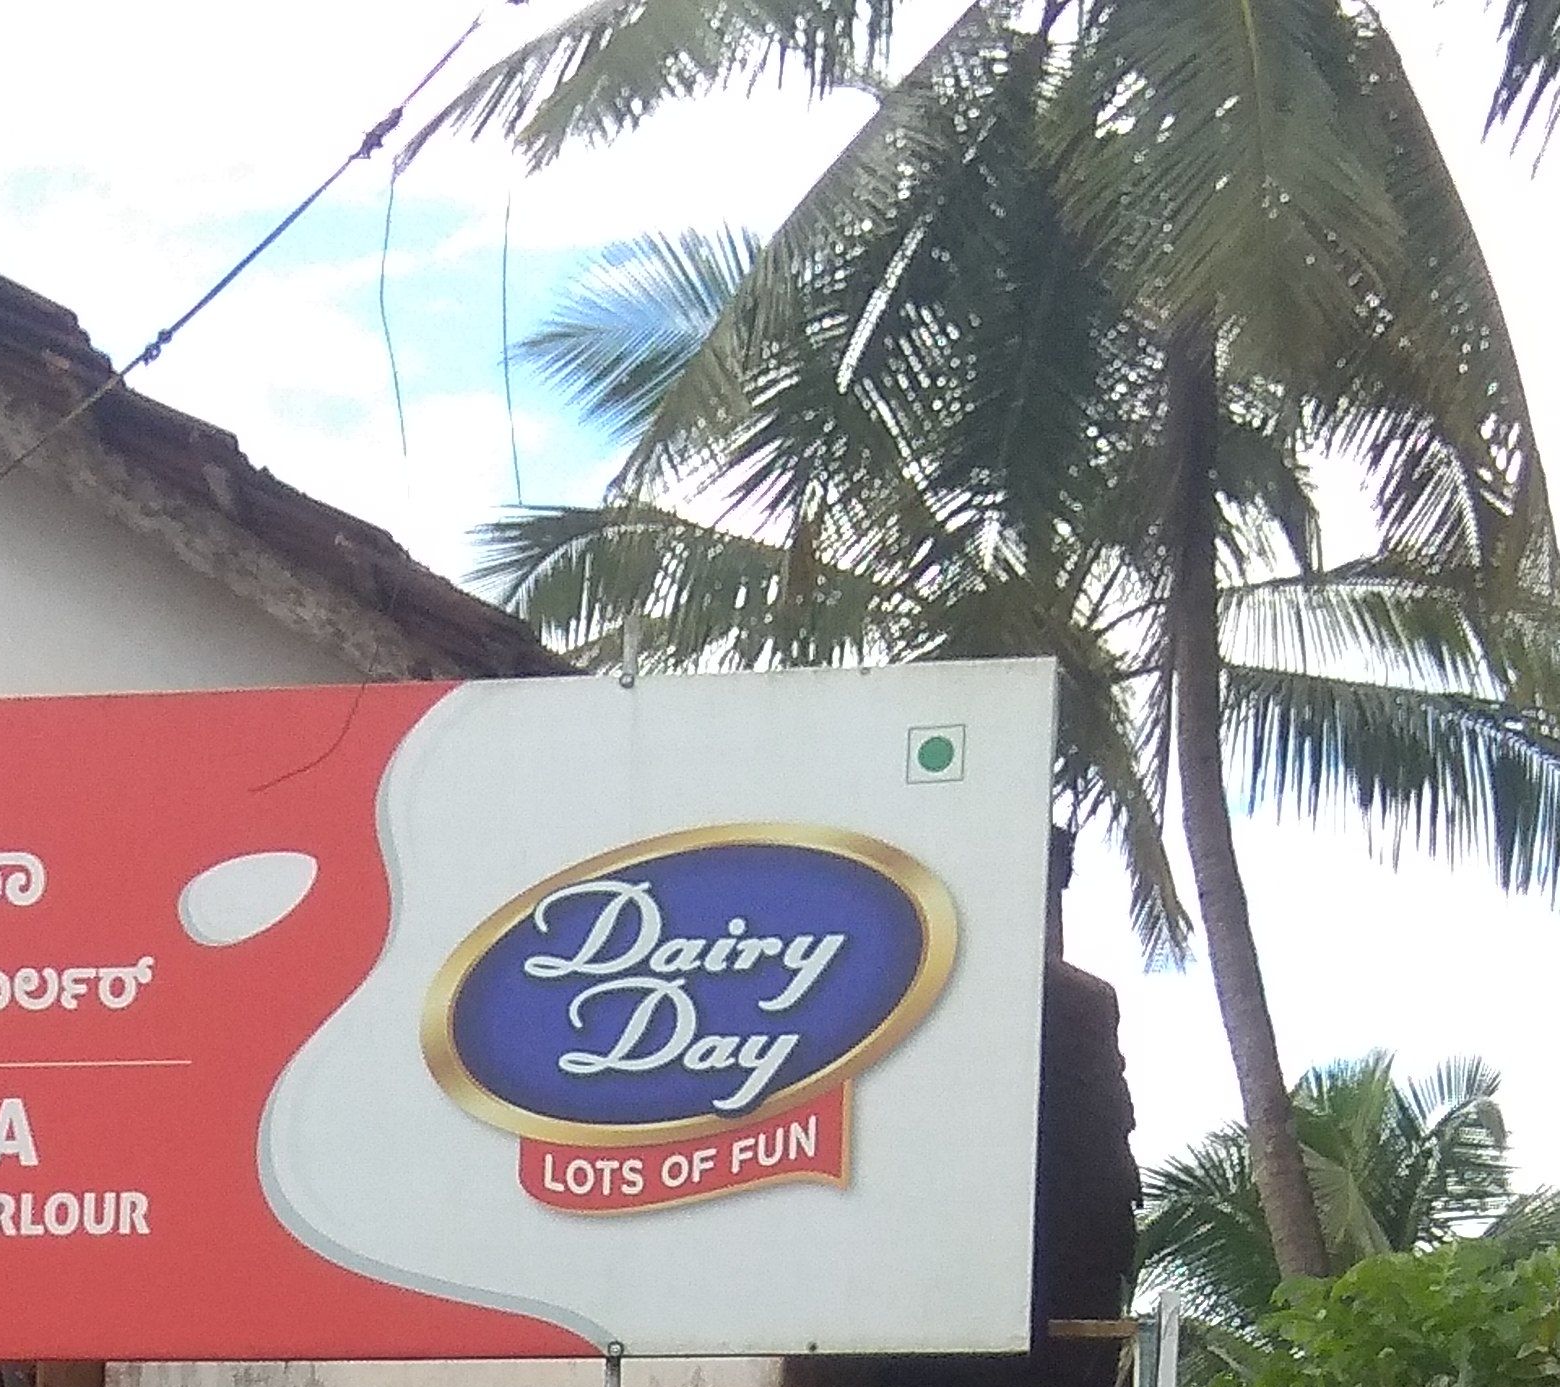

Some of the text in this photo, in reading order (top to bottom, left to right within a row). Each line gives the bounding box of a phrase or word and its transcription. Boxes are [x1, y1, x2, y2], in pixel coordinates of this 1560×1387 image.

[524, 879, 844, 1012] Dairy
[557, 976, 799, 1111] Day
[543, 1113, 818, 1197] LOTS OF FUN
